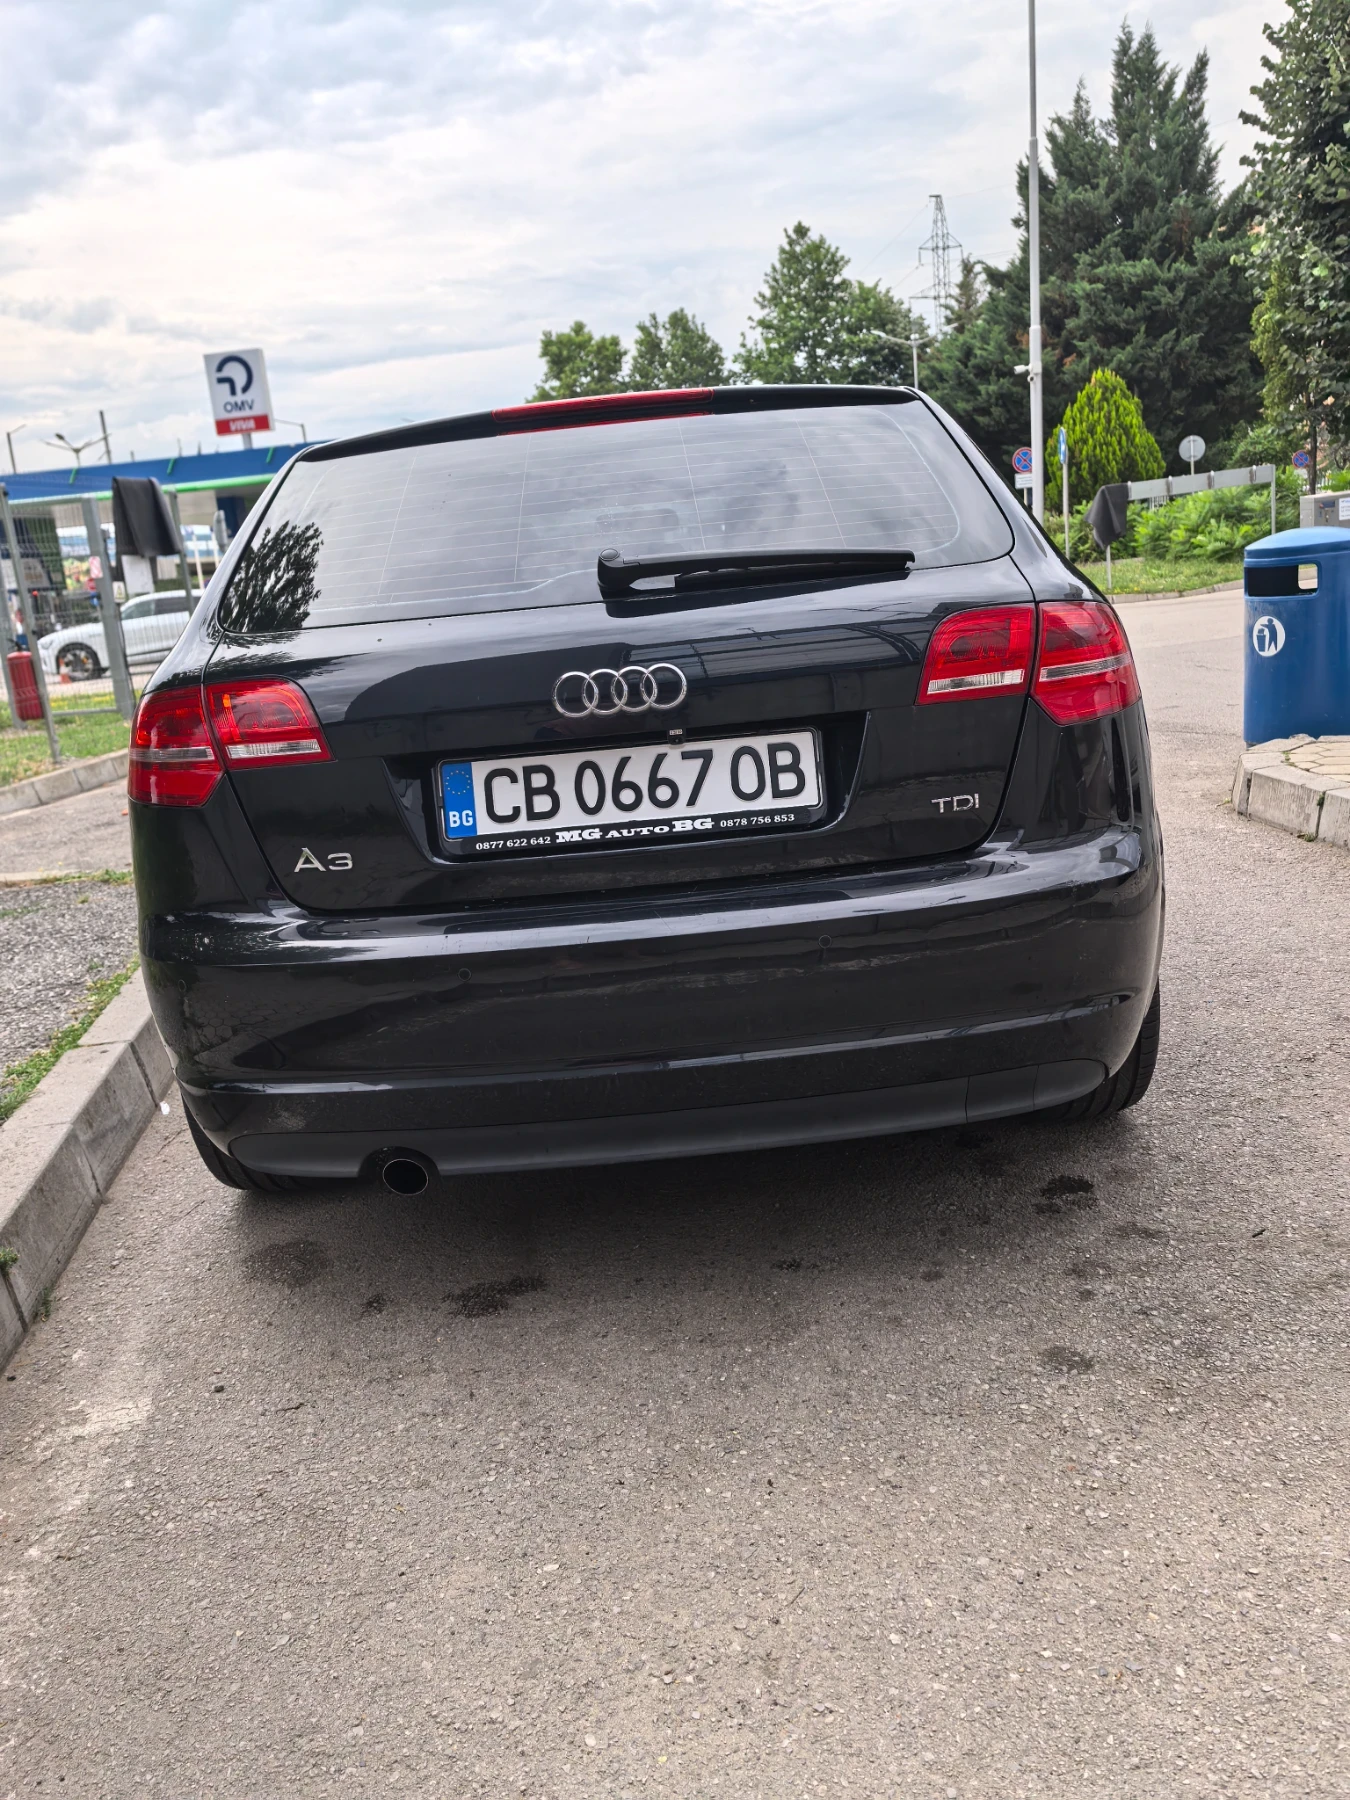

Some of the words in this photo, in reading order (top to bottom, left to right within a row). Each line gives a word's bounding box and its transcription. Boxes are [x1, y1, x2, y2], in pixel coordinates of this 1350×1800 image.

[223, 399, 254, 413] OMV
[229, 418, 256, 432] VIVA
[484, 764, 560, 824] CB
[574, 748, 714, 816] 0667
[931, 793, 979, 813] TDI
[449, 810, 474, 828] BG
[476, 840, 503, 850] 0877
[506, 838, 528, 848] 622
[530, 836, 551, 845] 642
[555, 828, 603, 843] MG
[605, 824, 670, 839] AUTO
[672, 817, 715, 832] BG
[720, 818, 748, 828] 0878
[751, 815, 772, 825] 756
[774, 813, 795, 823] 853
[294, 847, 353, 873] A3
